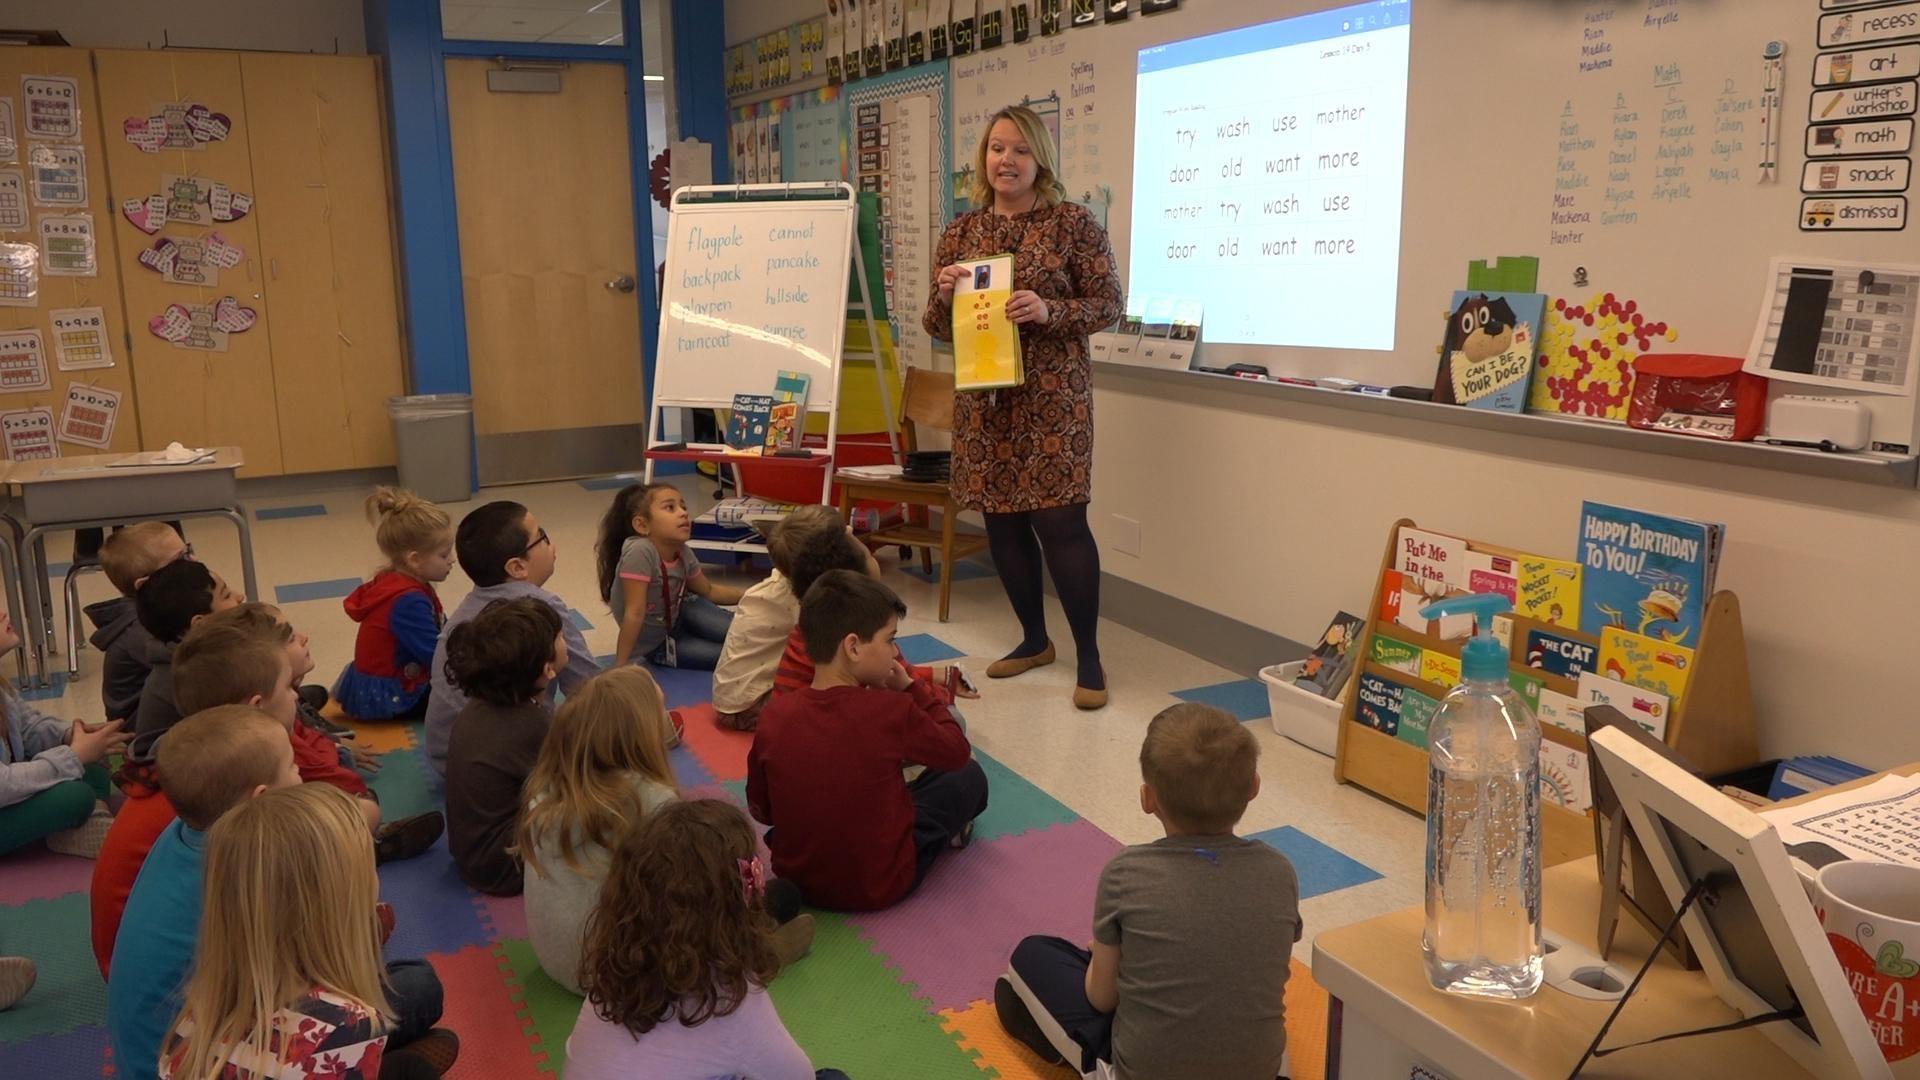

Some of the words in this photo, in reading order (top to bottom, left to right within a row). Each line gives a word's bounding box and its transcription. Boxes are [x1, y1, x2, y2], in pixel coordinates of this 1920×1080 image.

[981, 14, 1000, 39] Hh
[1862, 12, 1918, 33] recess
[954, 20, 974, 54] Gg
[1071, 61, 1094, 80] Spelling
[1869, 53, 1898, 71] art
[1654, 63, 1681, 82] Math
[63, 88, 72, 98] 12
[1854, 86, 1904, 102] writer's
[1846, 99, 1909, 115] workshop
[1176, 128, 1198, 151] try
[1216, 116, 1251, 140] wash
[1272, 115, 1298, 132] use
[1316, 104, 1366, 125] mother
[1855, 127, 1897, 144] math
[1169, 164, 1200, 183] door
[1221, 156, 1243, 178] old
[1265, 153, 1301, 174] want
[1318, 151, 1360, 170] more
[1849, 165, 1896, 182] snack
[1164, 202, 1202, 220] mother
[1220, 201, 1242, 224] try
[1263, 193, 1300, 215] wash
[1323, 195, 1351, 212] use
[1839, 204, 1899, 219] dismissal
[78, 225, 88, 234] 16
[1549, 229, 1584, 245] Hunter
[688, 225, 744, 260] flagpole
[769, 221, 815, 242] cannot
[1166, 240, 1197, 259] door
[1218, 237, 1240, 257] old
[1261, 237, 1298, 257] want
[1314, 238, 1356, 255] more
[683, 264, 742, 291] backpack
[766, 251, 819, 275] pancake
[765, 285, 809, 304] hillside
[91, 317, 100, 326] 18
[678, 329, 731, 351] raincoat
[1465, 364, 1486, 378] CAN
[1489, 361, 1496, 370] I
[1499, 352, 1515, 366] BE
[1462, 375, 1492, 397] YOUR
[1495, 356, 1527, 384] DOG?
[70, 391, 78, 401] 10
[87, 396, 96, 405] 10
[103, 399, 116, 409] 20
[38, 417, 48, 426] 10
[1584, 515, 1629, 547] HAPPY
[1629, 522, 1699, 563] BIRTHDAY
[1405, 537, 1426, 557] Put
[1428, 544, 1447, 562] Me
[1405, 557, 1419, 573] in
[1421, 564, 1444, 581] the
[1604, 544, 1647, 579] YOU!
[1472, 573, 1497, 590] Spring
[1375, 639, 1412, 660] Summer
[1539, 638, 1560, 653] THE
[1560, 641, 1594, 664] CAT
[1569, 662, 1582, 673] IN
[1368, 680, 1384, 694] CAT
[1590, 689, 1610, 704] The
[1359, 689, 1387, 707] COMES
[1870, 818, 1893, 830] We
[1851, 834, 1891, 851] sloth
